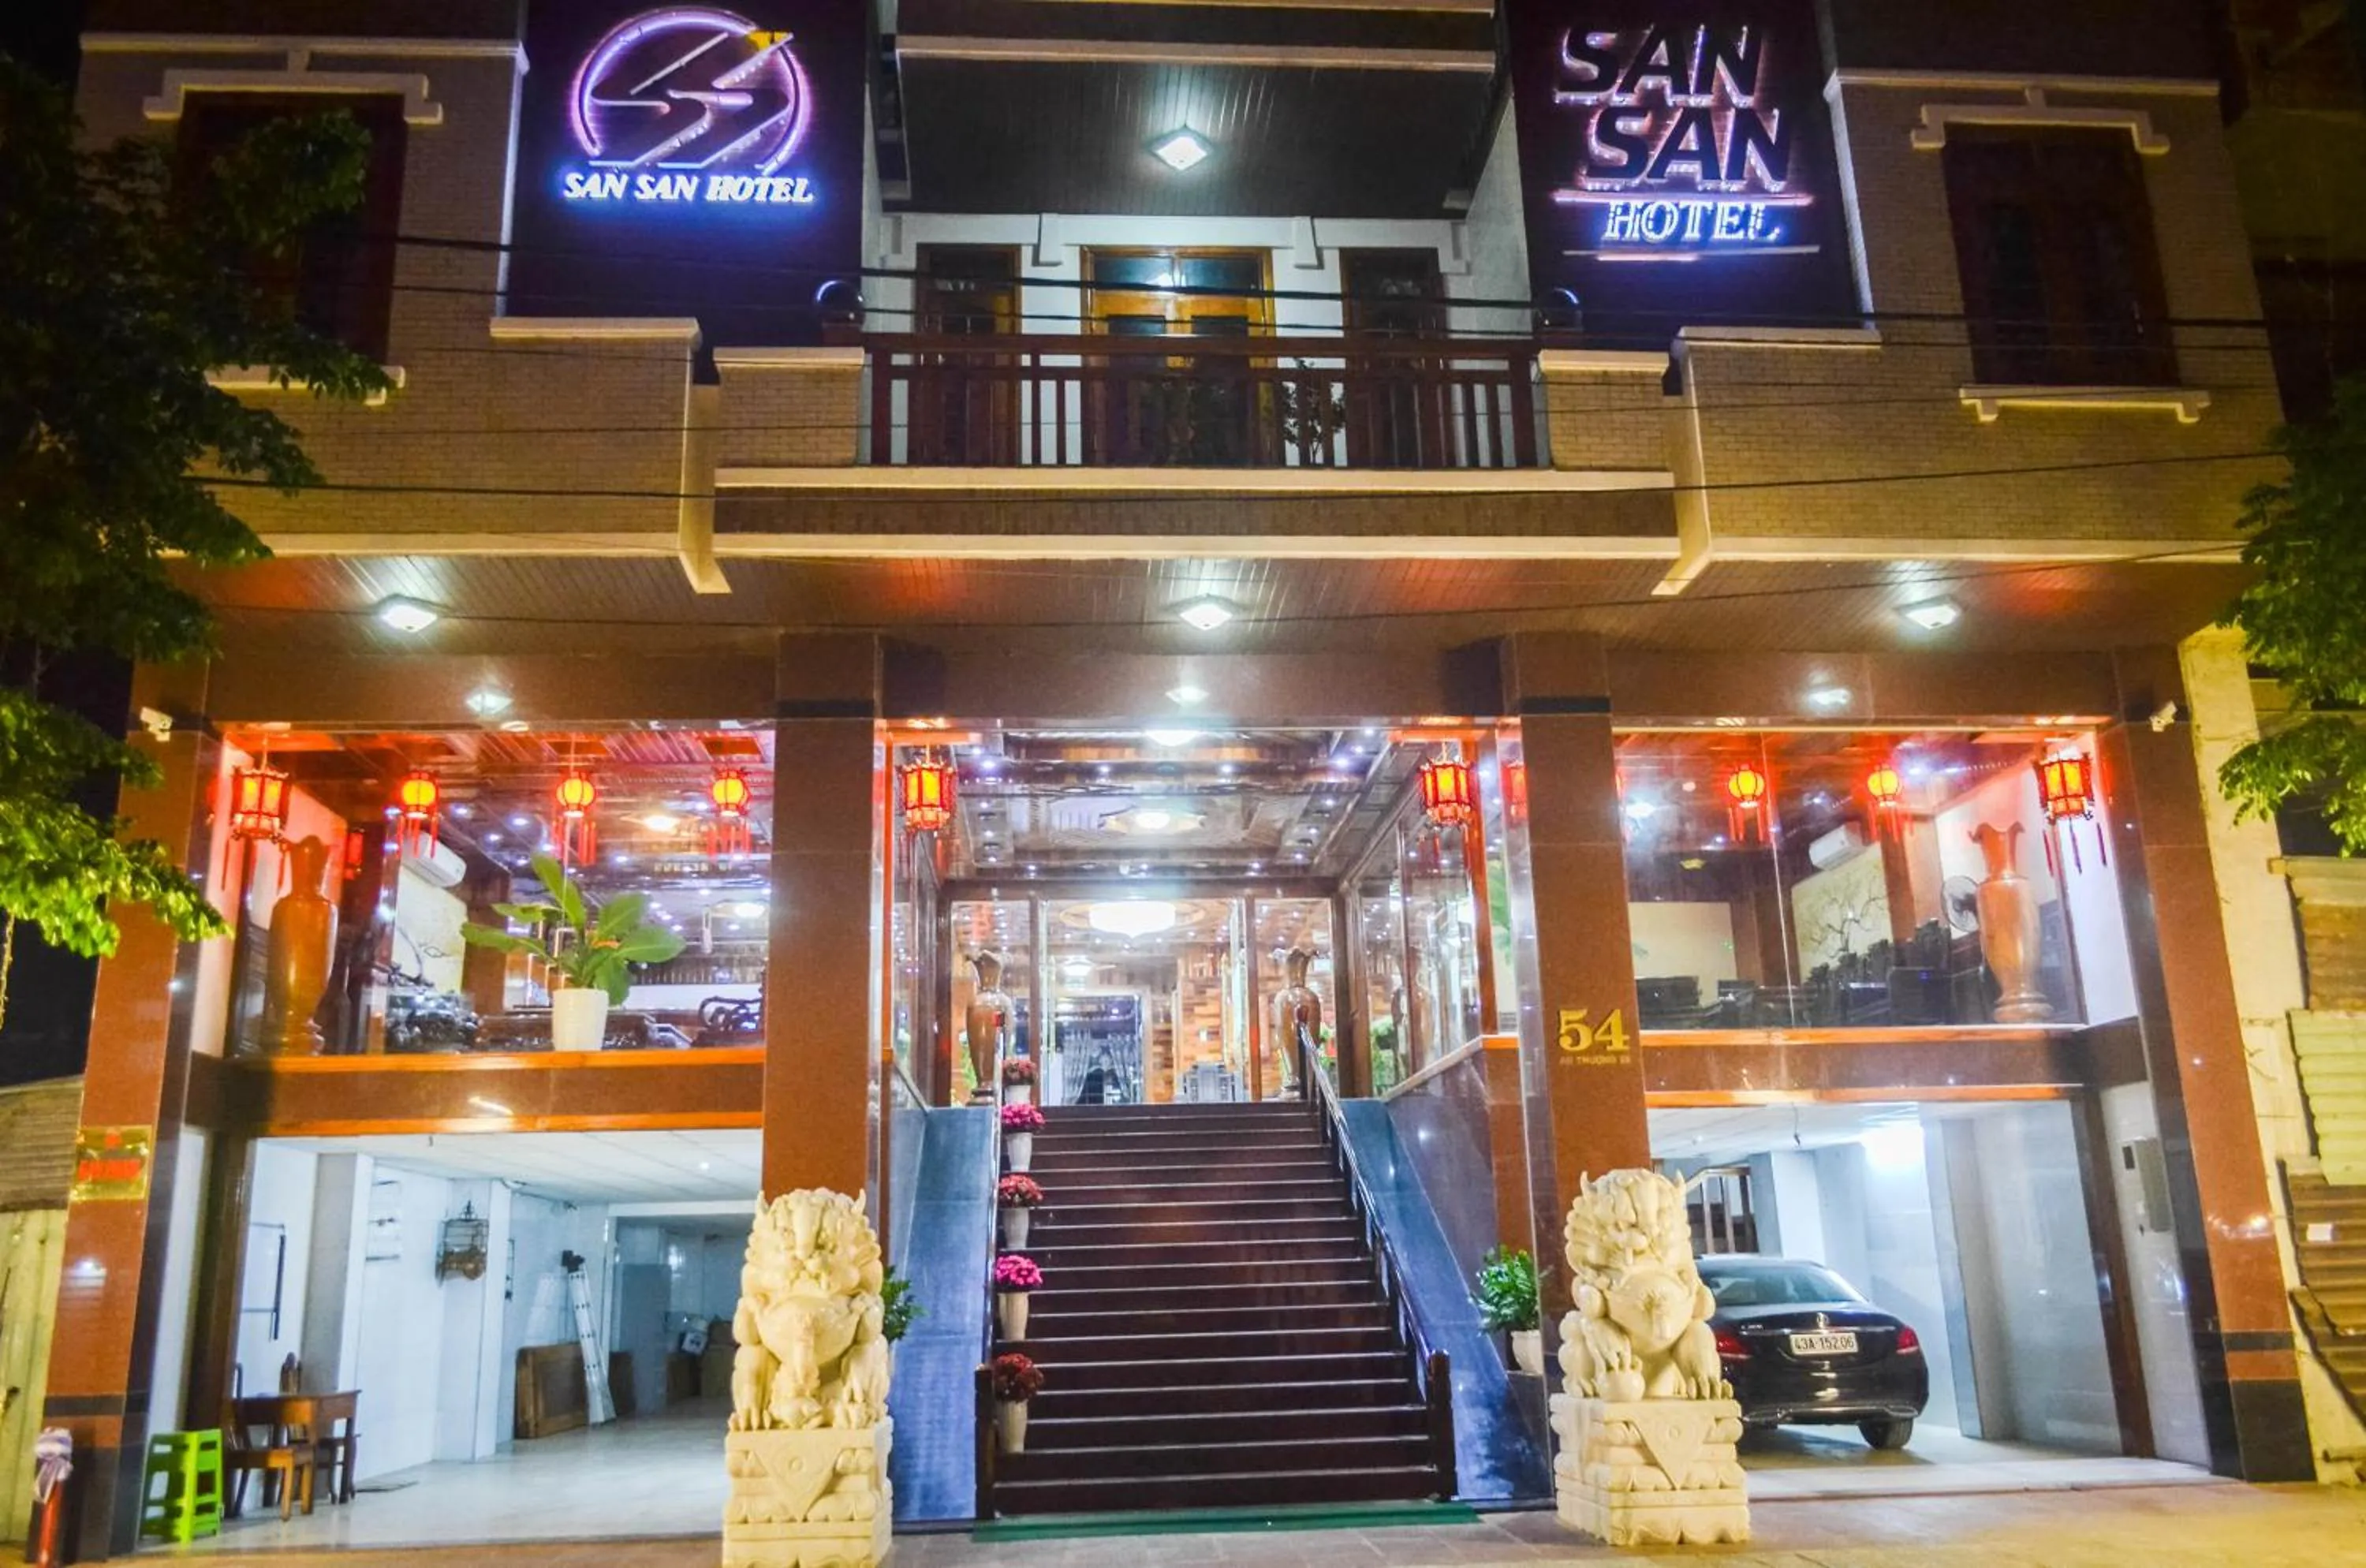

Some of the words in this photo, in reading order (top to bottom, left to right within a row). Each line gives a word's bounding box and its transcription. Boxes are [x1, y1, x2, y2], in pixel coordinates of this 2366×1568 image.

[1554, 24, 1767, 106] SAN
[1577, 107, 1792, 192] SAN
[562, 171, 629, 199] SAN
[634, 174, 700, 201] SAN
[706, 175, 814, 203] HOTEL
[1601, 200, 1781, 241] HOTEL
[1558, 1009, 1630, 1051] 54
